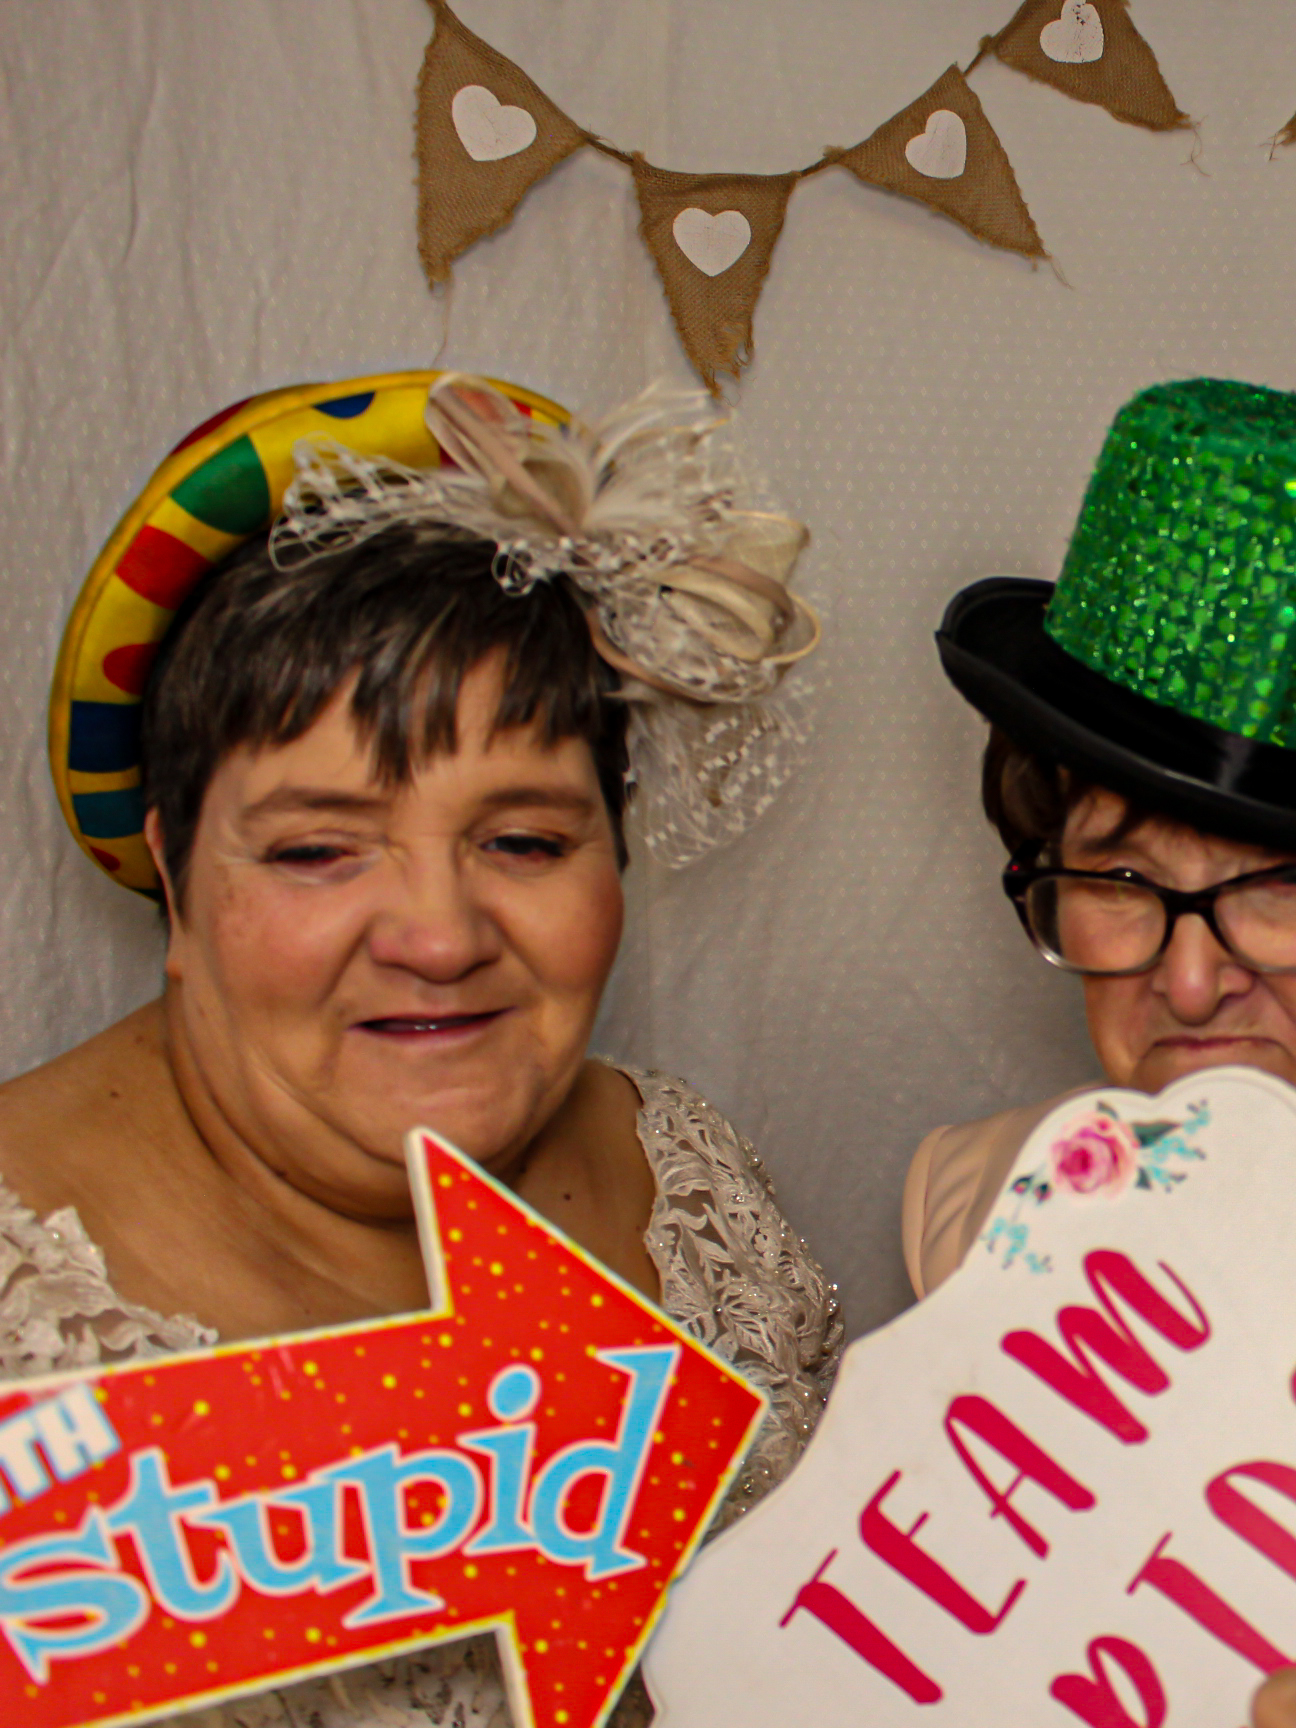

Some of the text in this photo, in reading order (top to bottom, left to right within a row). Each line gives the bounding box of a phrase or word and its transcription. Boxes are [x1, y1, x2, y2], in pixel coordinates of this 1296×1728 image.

[0, 1377, 121, 1516] TH
[0, 1344, 682, 1684] stupid
[779, 1249, 1212, 1705] TEAM
